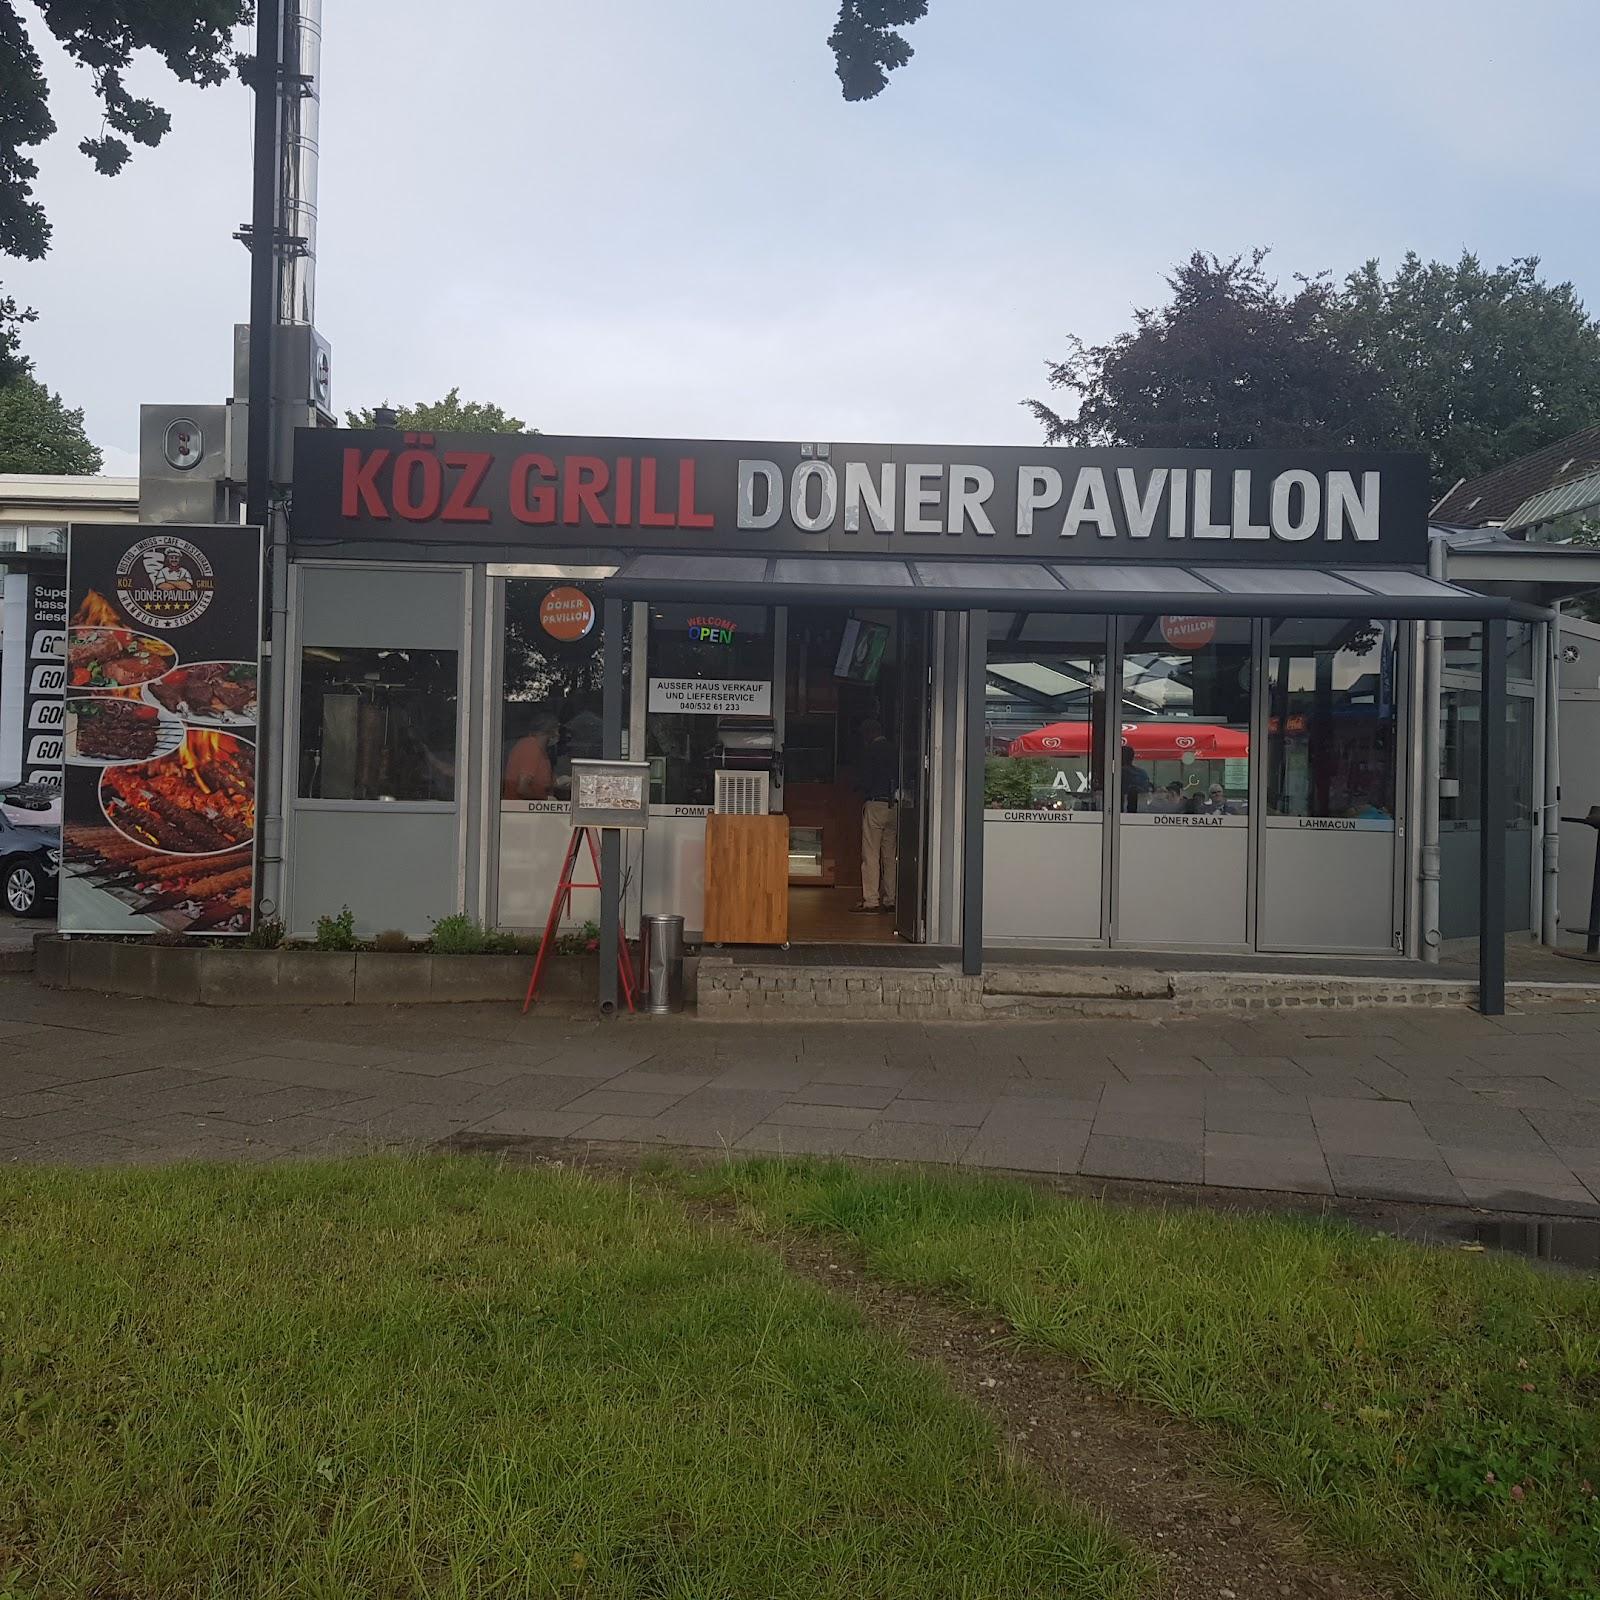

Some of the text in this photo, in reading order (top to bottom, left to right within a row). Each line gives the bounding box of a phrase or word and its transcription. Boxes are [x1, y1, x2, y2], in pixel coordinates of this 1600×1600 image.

[341, 433, 1381, 541] KÖZ GRILL DÖNER PAVILLON
[118, 551, 135, 573] BISTRO
[136, 538, 158, 551] IMBISS
[183, 541, 212, 574] RESTAURANT
[196, 579, 214, 588] GRILL
[134, 587, 198, 601] DÖNER PAVILLON
[122, 596, 159, 626] HAMBURG
[543, 611, 590, 624] PAVILLON
[687, 616, 738, 631] WELCOME
[1167, 620, 1215, 636] PAVILLON
[688, 626, 733, 644] OPEN
[657, 682, 764, 692] AUSSER HAUS VERKAUF
[665, 692, 755, 701] UND LIEFERSERVICE
[680, 702, 740, 711] 040/532 61 233
[1004, 811, 1074, 822] CURRYWURST
[1153, 815, 1224, 826] DÖNER SALAT
[1299, 819, 1356, 830] LAHMACUN
